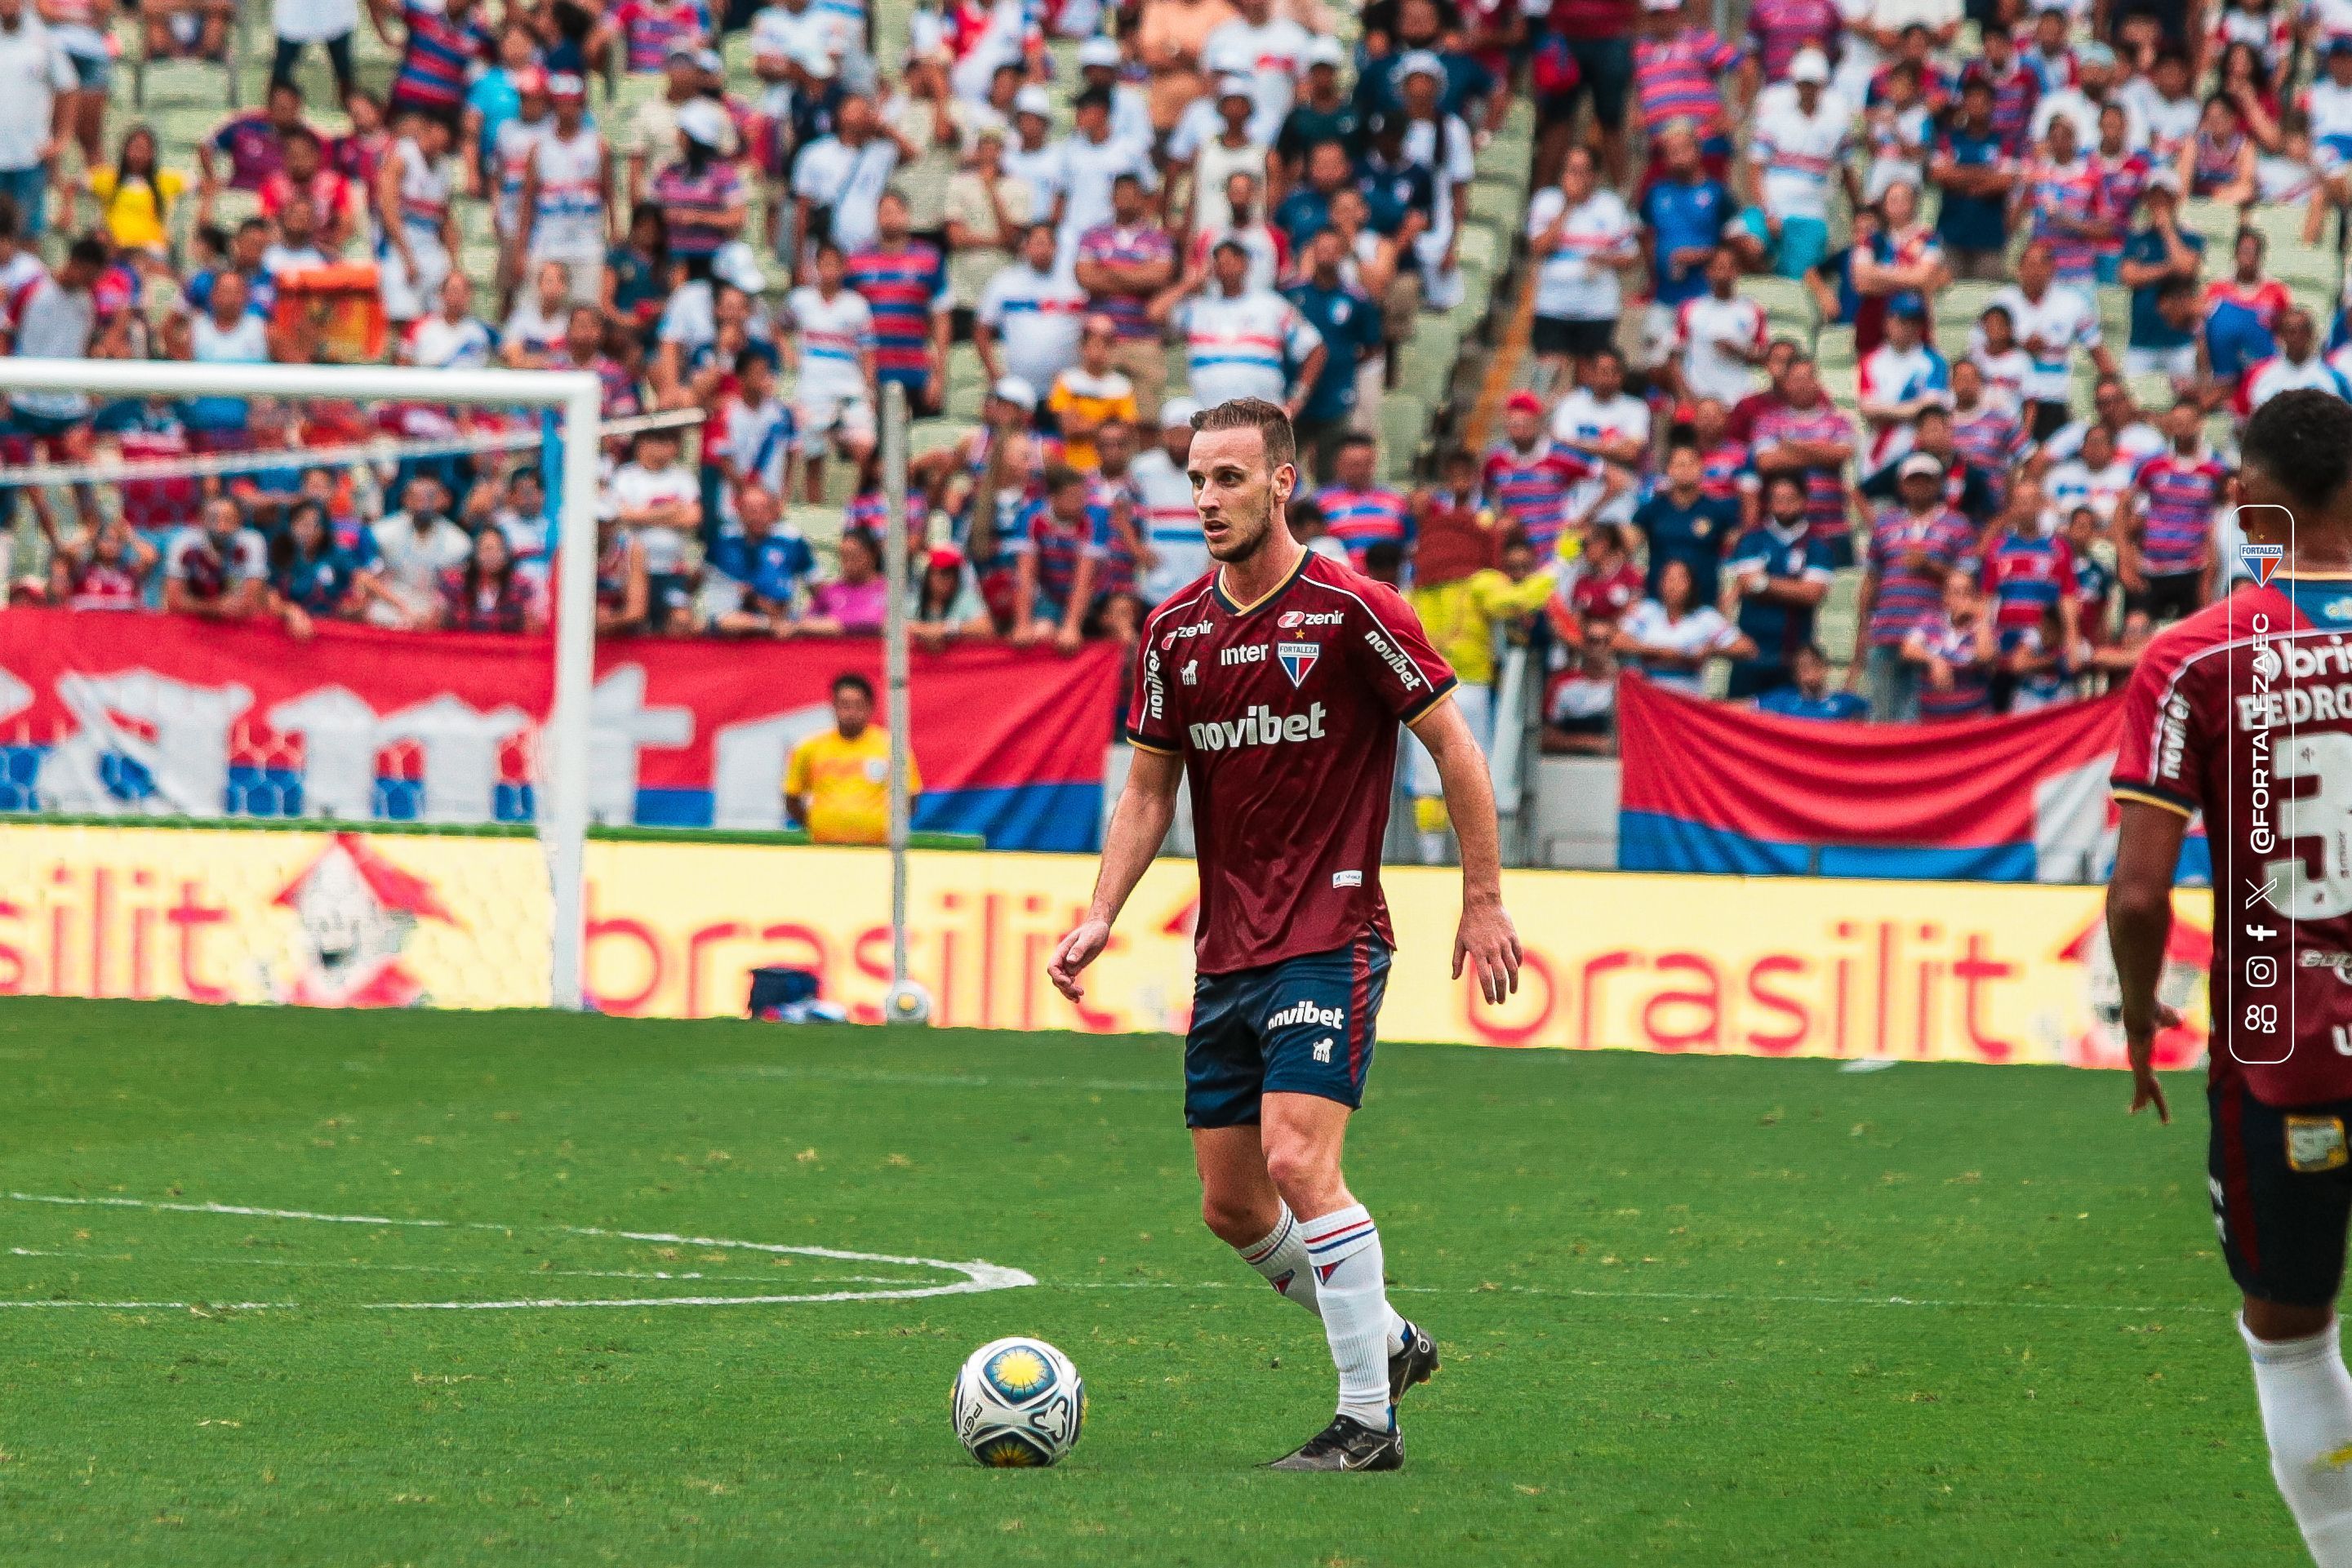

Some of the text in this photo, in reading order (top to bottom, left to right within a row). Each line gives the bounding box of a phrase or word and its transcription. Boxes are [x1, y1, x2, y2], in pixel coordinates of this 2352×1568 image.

[1178, 620, 1214, 637] zenir
[1306, 611, 1344, 624] zenir
[1279, 645, 1318, 654] FORTALEZA
[1364, 631, 1421, 691] novibet
[1189, 701, 1326, 751] novibet
[963, 1402, 983, 1452] PEN
